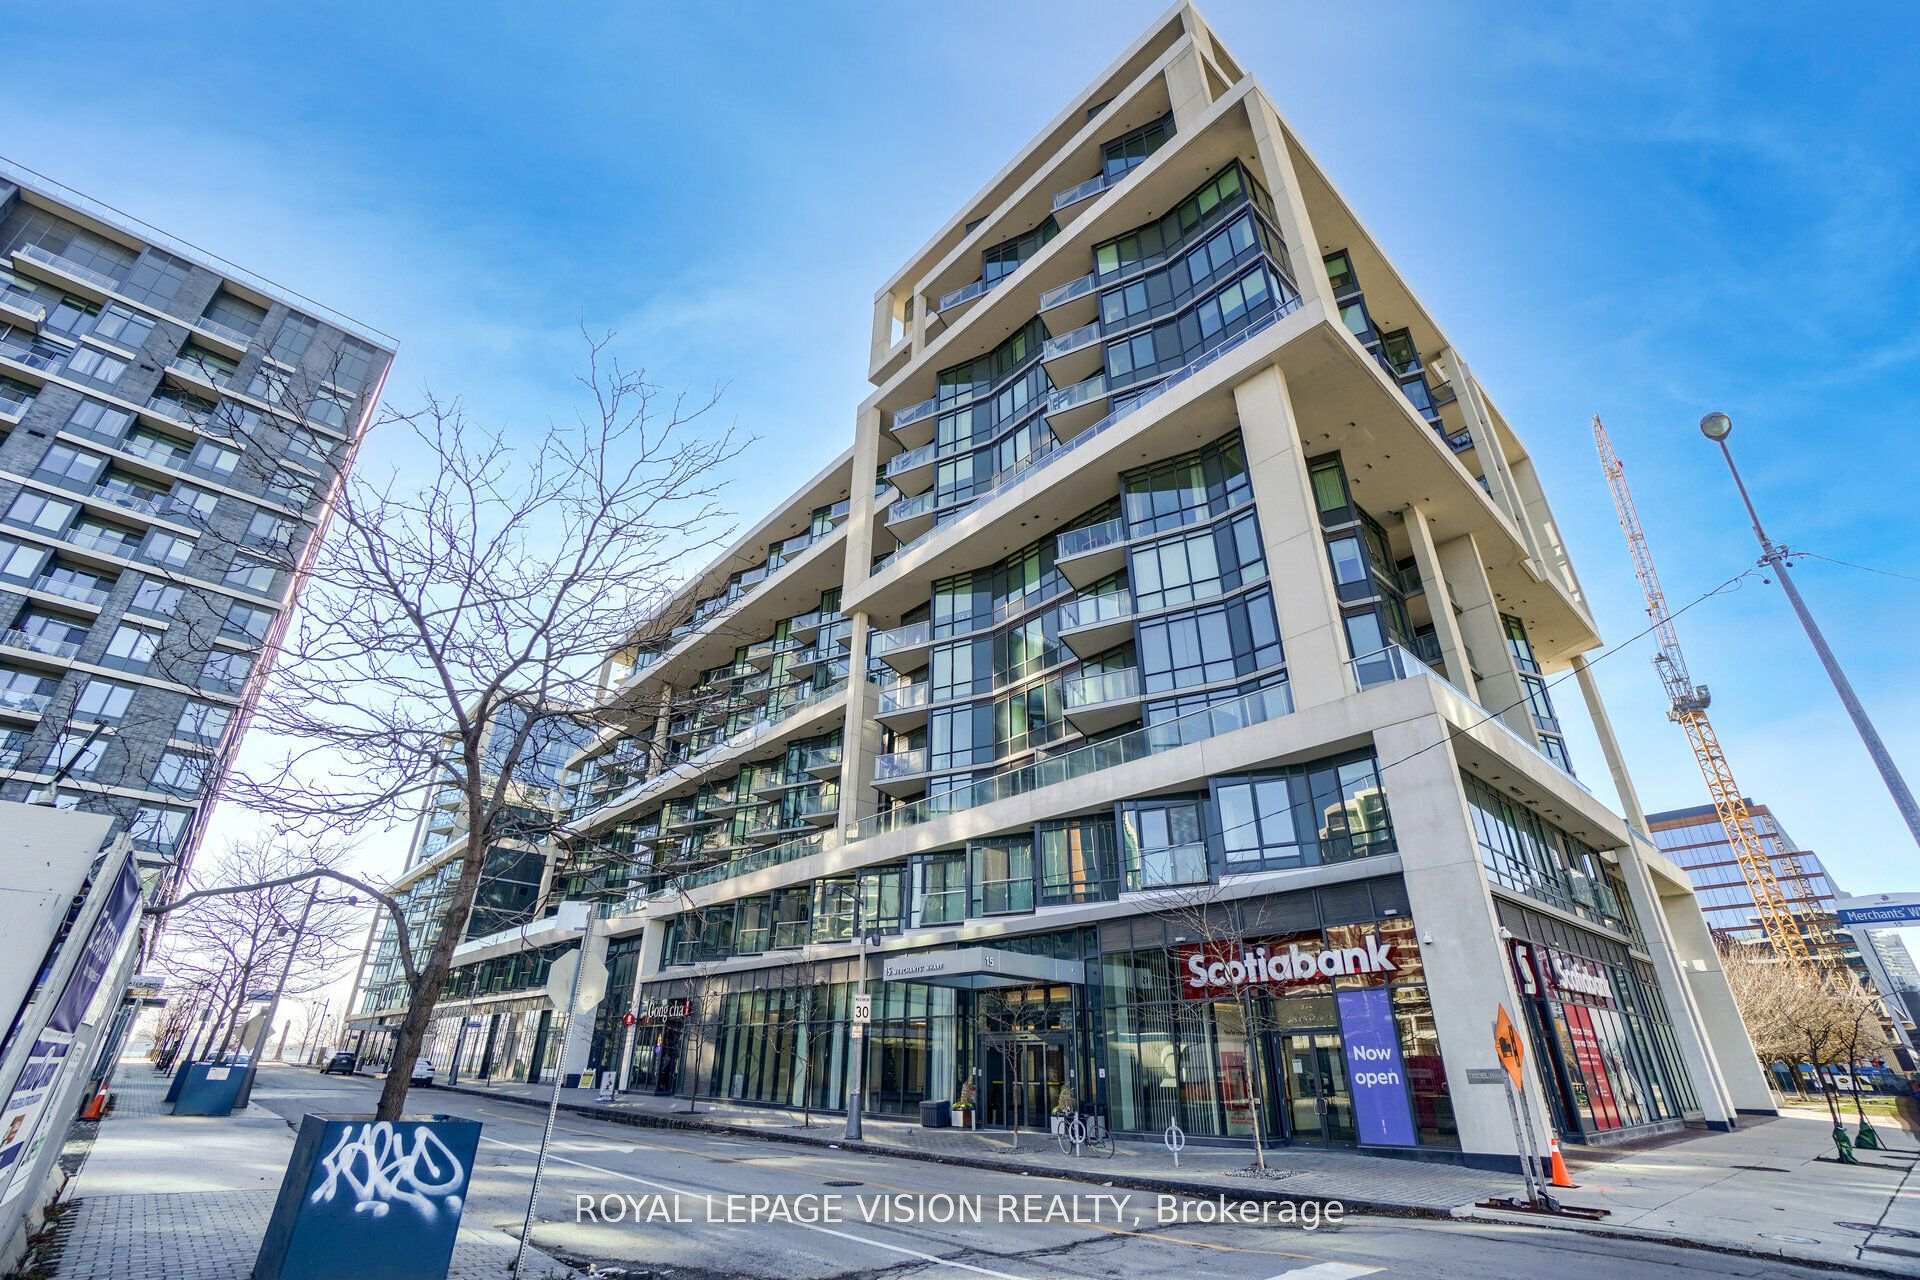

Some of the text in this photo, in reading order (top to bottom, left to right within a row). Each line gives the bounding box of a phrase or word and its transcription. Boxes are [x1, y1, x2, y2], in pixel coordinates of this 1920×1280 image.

[985, 955, 995, 967] 15
[1188, 934, 1397, 988] Scotiabank
[647, 999, 684, 1023] Gong cha
[855, 1006, 869, 1018] 30
[1352, 1045, 1392, 1061] Now
[1355, 1072, 1400, 1088] open
